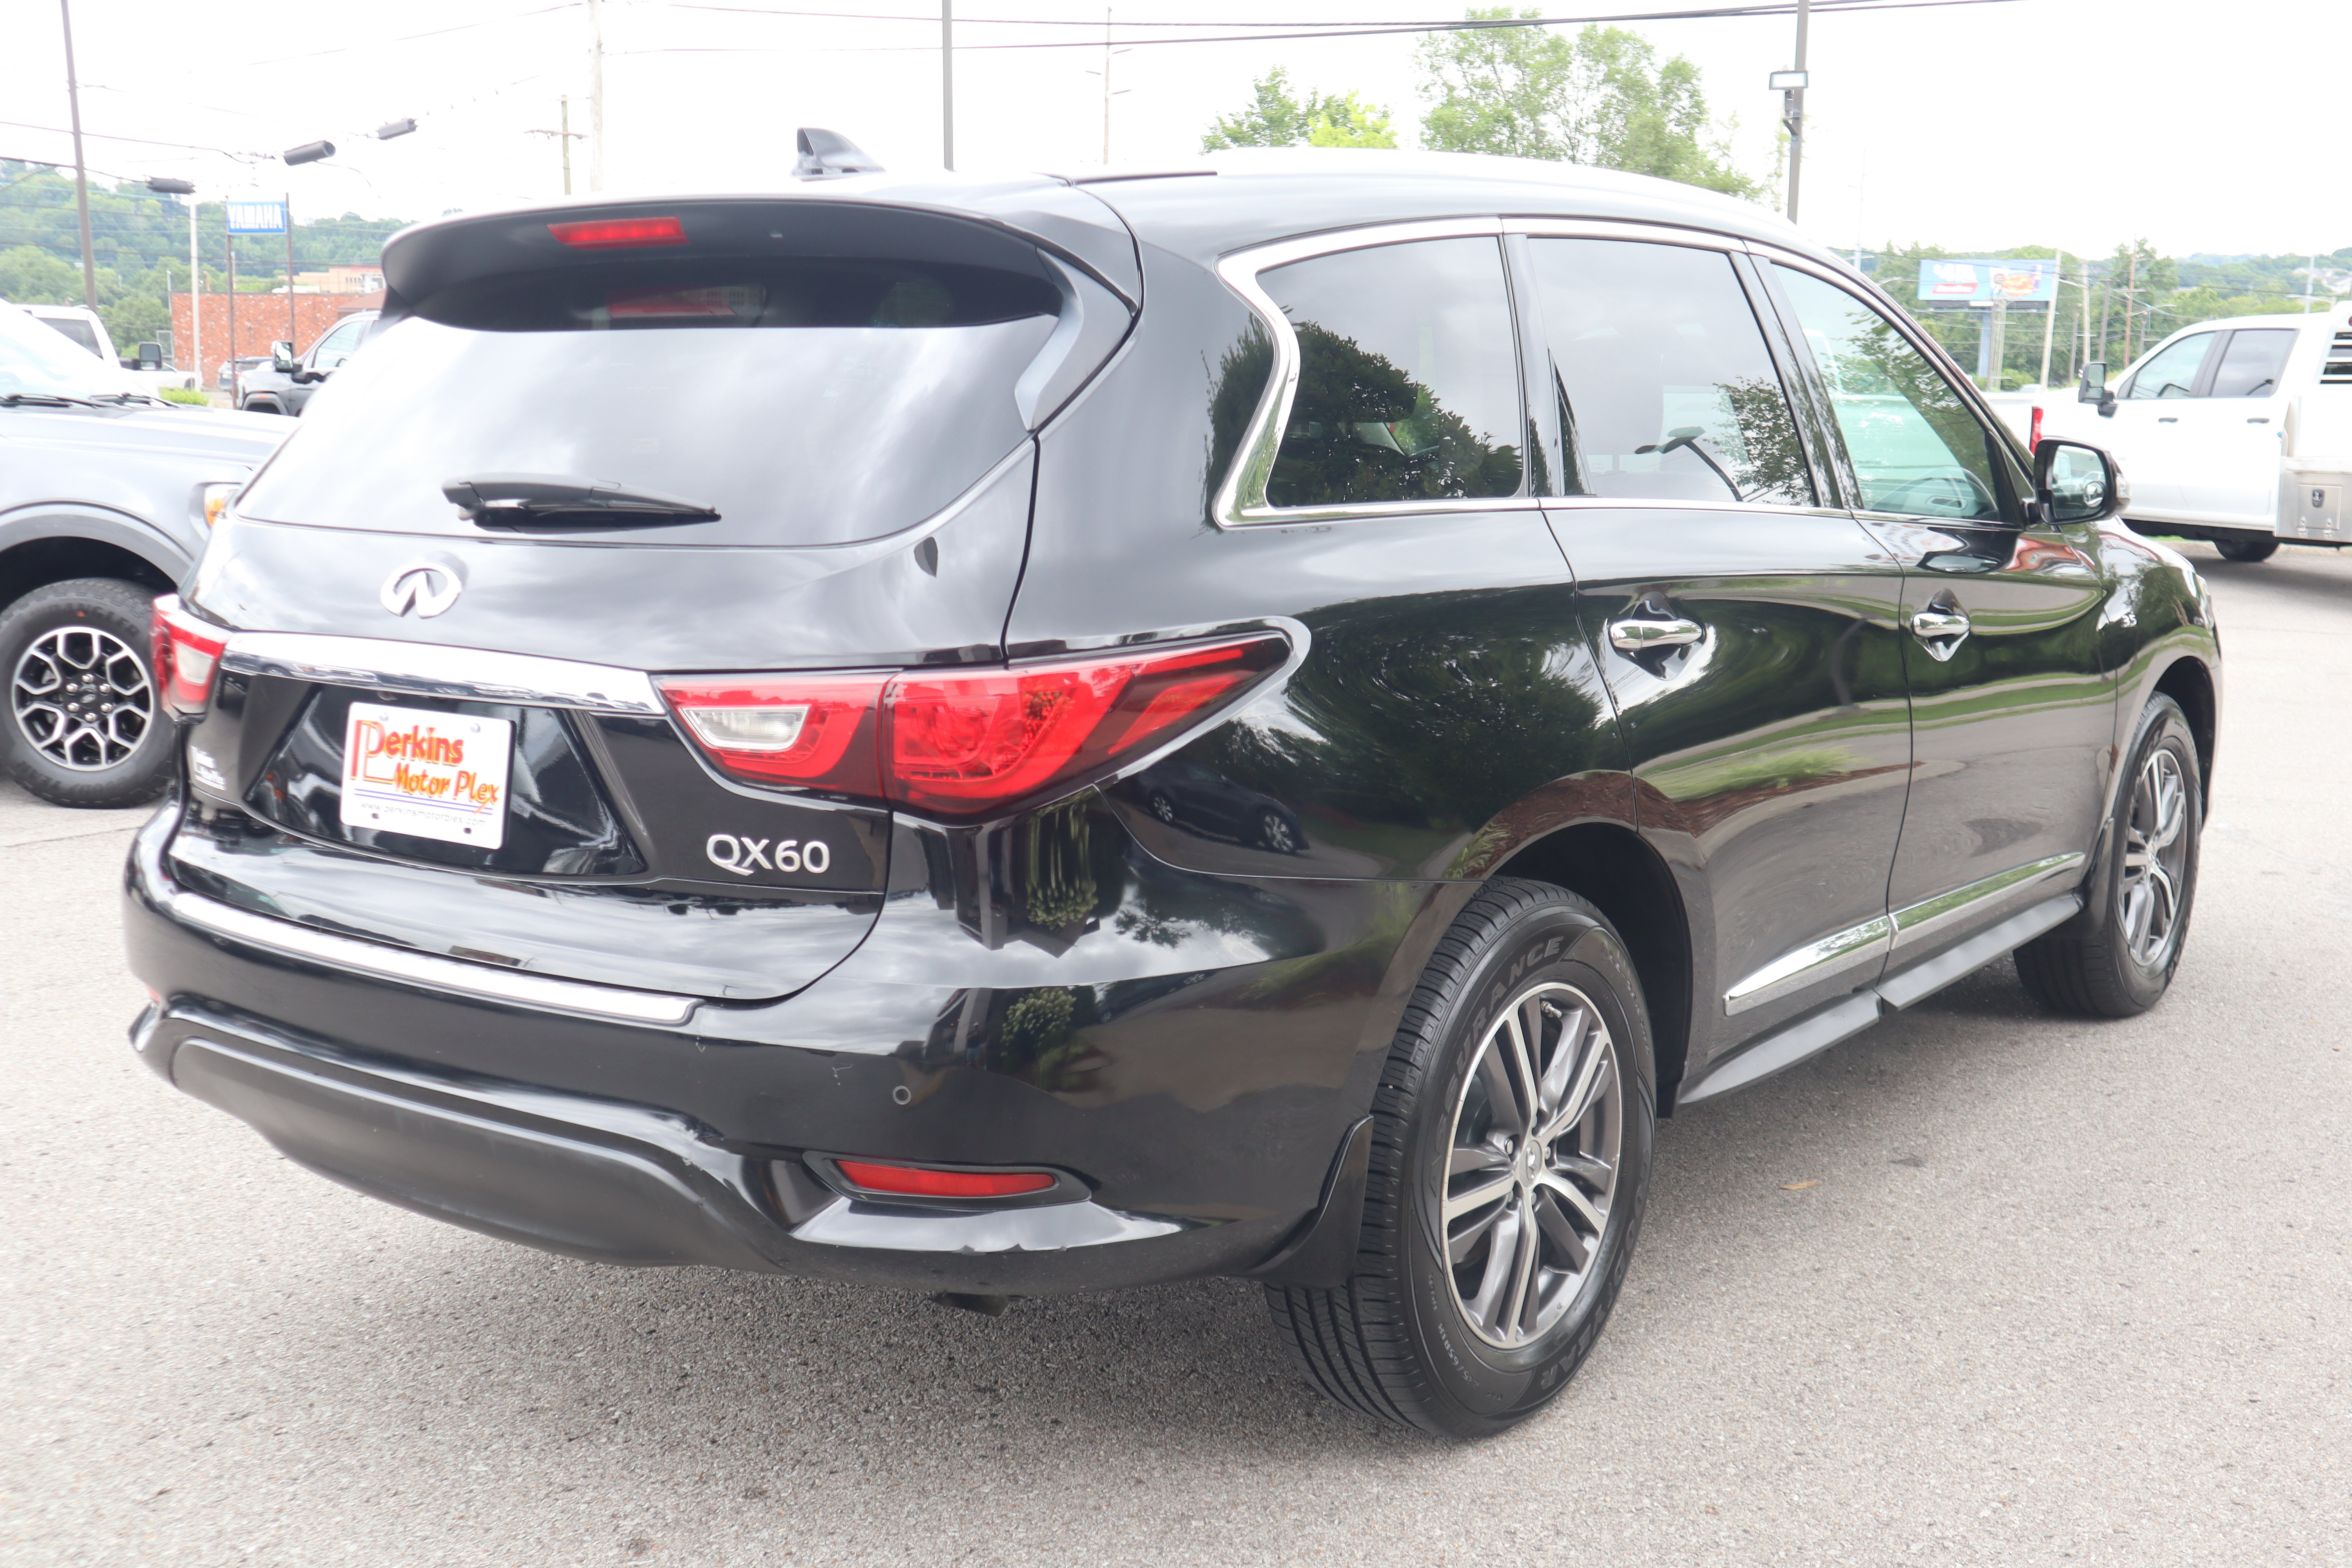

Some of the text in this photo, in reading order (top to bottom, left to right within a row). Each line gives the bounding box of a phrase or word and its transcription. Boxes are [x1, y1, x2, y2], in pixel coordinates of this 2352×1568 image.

[228, 205, 283, 229] YAMAHA
[350, 719, 465, 780] Perkins
[395, 762, 500, 814] Motor Plex
[360, 802, 486, 826] wwwperkinsmotorplexcom
[706, 834, 831, 876] QX60
[1541, 1148, 1650, 1392] GOODYEAR
